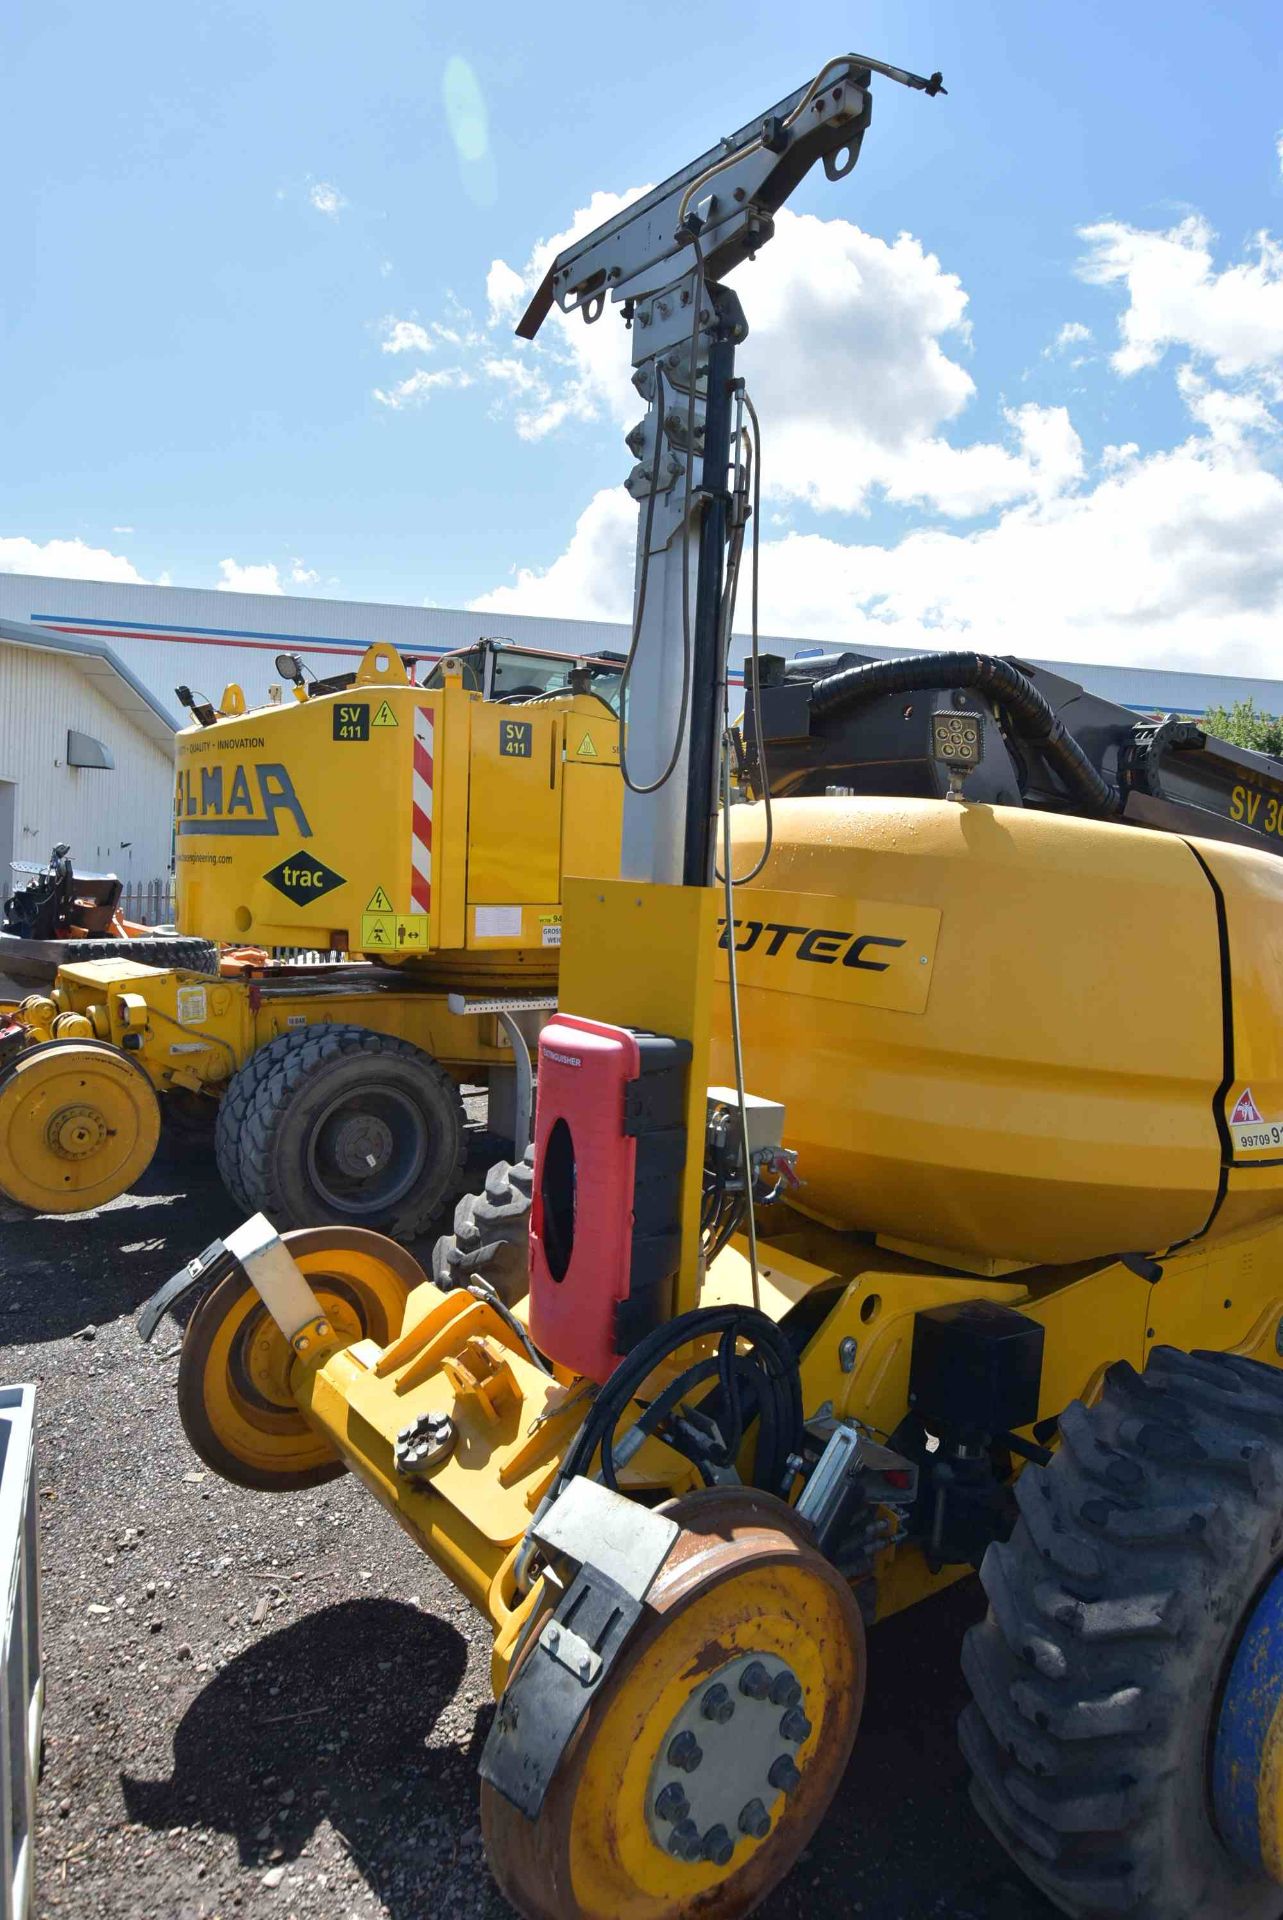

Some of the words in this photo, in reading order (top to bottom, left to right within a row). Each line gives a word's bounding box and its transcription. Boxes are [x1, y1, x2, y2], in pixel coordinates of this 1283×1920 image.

[340, 707, 361, 722] SV
[340, 725, 361, 738] 411
[506, 724, 525, 740] SV
[190, 742, 211, 754] QUALITY
[217, 737, 265, 750] INNOVATION
[506, 742, 525, 755] 411
[1229, 785, 1262, 825] SV
[283, 865, 323, 888] trac
[717, 918, 907, 972] OTEC
[1240, 1134, 1271, 1148] 99709
